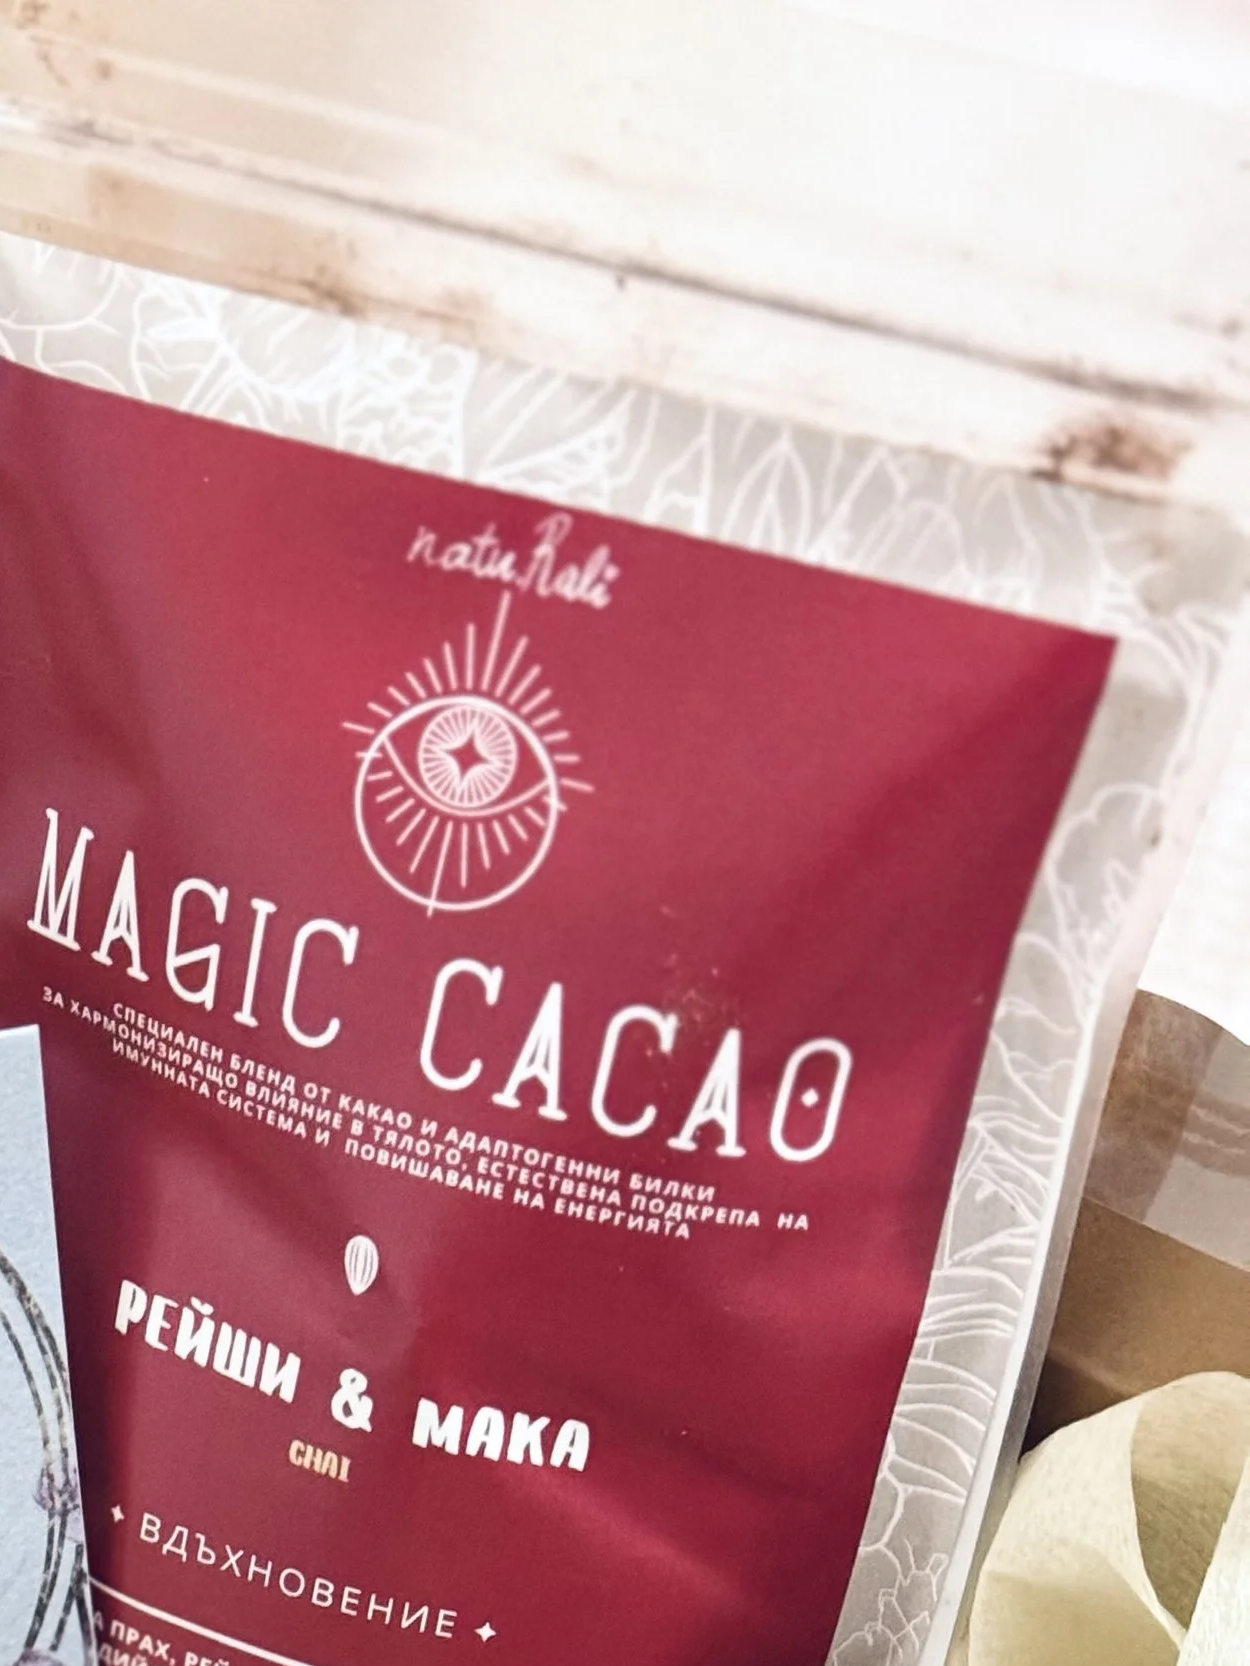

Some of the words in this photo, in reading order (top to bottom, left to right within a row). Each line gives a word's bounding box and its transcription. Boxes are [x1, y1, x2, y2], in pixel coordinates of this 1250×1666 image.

[27, 808, 360, 1048] MAGIC
[420, 958, 853, 1162] CACAO
[42, 986, 65, 1008] ЗА
[70, 999, 238, 1089] ХАРМОНИЗИРАЩО
[245, 1080, 342, 1130] ВЛИЯНИЕ
[350, 1119, 364, 1137] В
[373, 1124, 468, 1172] ТЯЛОТО,
[477, 1156, 622, 1206] ЕСТЕСТВЕНА
[630, 1194, 761, 1228] ПОДКРЕПА
[777, 1212, 810, 1231] НА
[112, 1038, 211, 1098] ИМУННАТА
[217, 1089, 307, 1139] СИСТЕМА
[315, 1129, 331, 1148] И
[344, 1138, 506, 1200] ПОВИШАВАНЕ
[513, 1187, 546, 1211] НА
[554, 1199, 691, 1240] ЕНЕРГИЯТА
[113, 1002, 224, 1062] СПЕЦИАЛЕН
[230, 1054, 296, 1095] БЛЕНД
[304, 1082, 331, 1104] ОТ
[338, 1094, 412, 1130] КАКАО
[420, 1118, 438, 1138] И
[444, 1127, 621, 1184] АДАПТОГЕННИ
[629, 1173, 716, 1202] БИЛКИ
[114, 1279, 301, 1404] РЕЙШИ
[330, 1367, 374, 1433] &
[411, 1397, 591, 1472] МАКА
[288, 1438, 352, 1484] CHAI
[110, 1618, 177, 1666] ПРАХ,
[139, 1512, 459, 1639] ВДЪХНОВЕНИЕ
